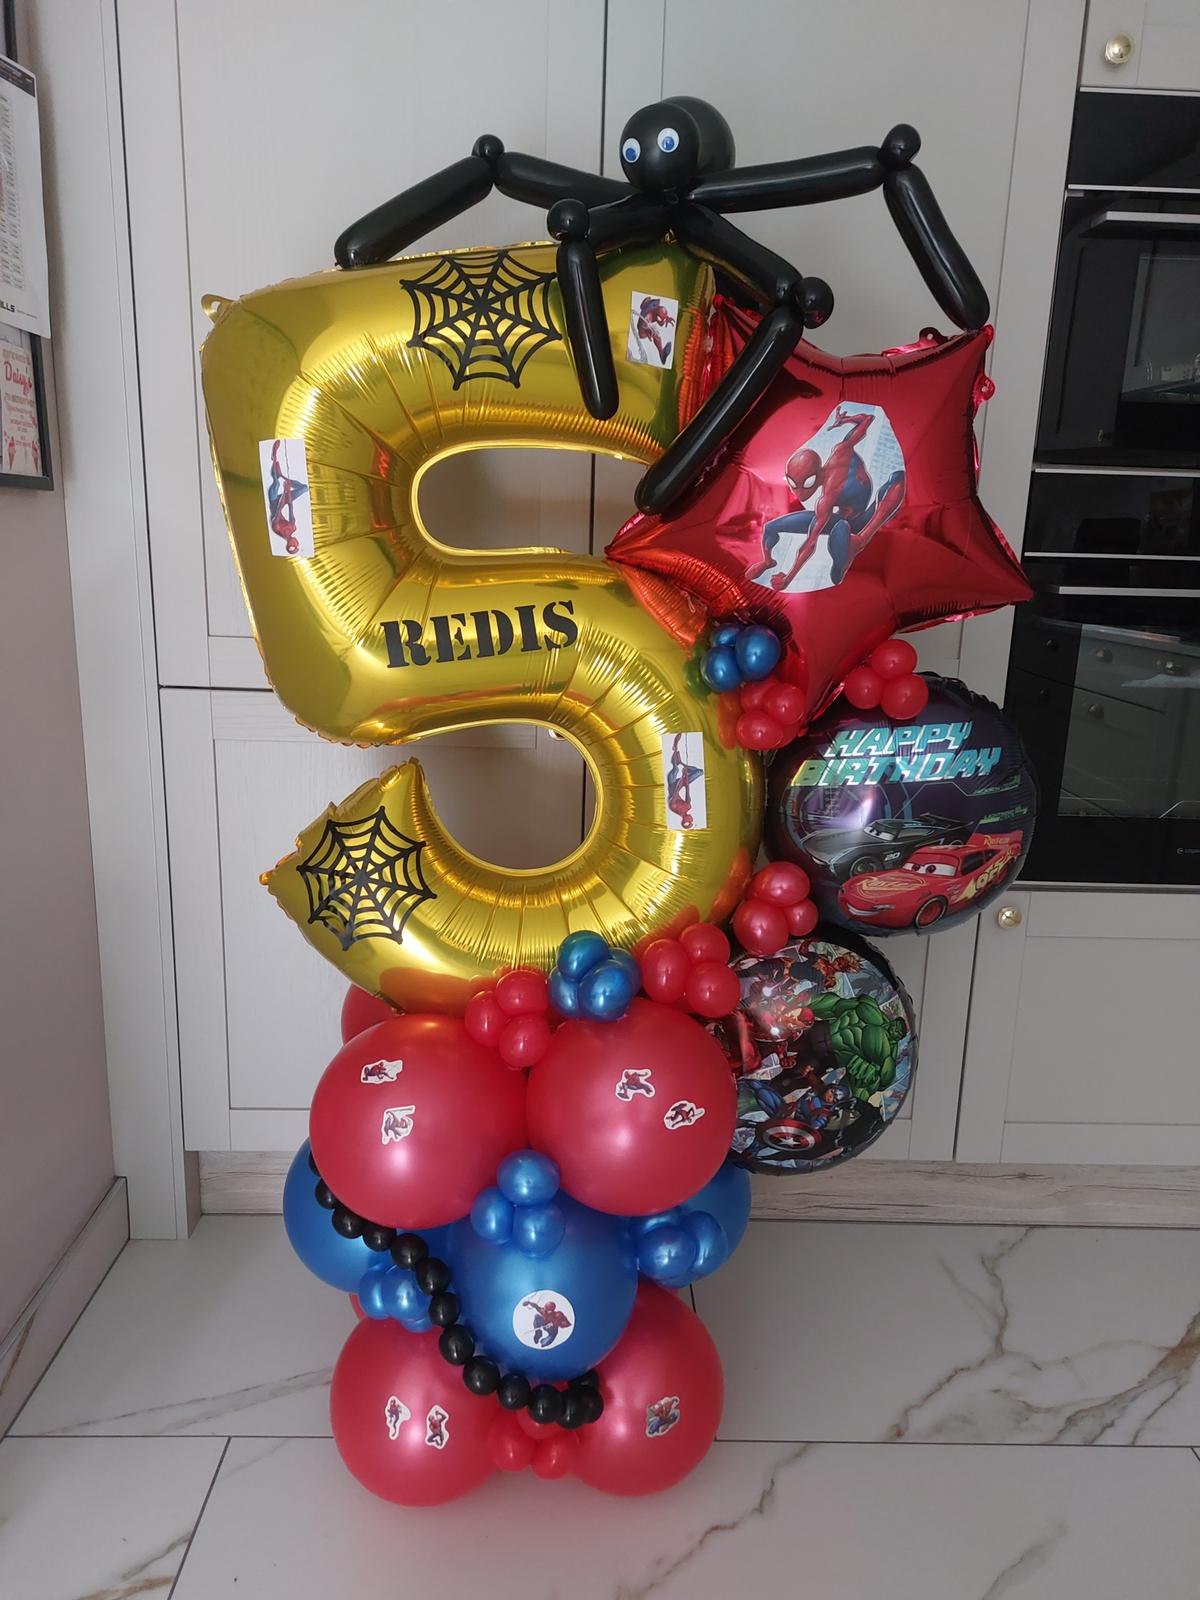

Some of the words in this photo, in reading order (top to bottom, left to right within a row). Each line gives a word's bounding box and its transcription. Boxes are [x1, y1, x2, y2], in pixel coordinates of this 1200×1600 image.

[380, 600, 579, 668] REDIS
[825, 721, 973, 757] HAPPY
[790, 748, 1001, 786] BIRTHDAY
